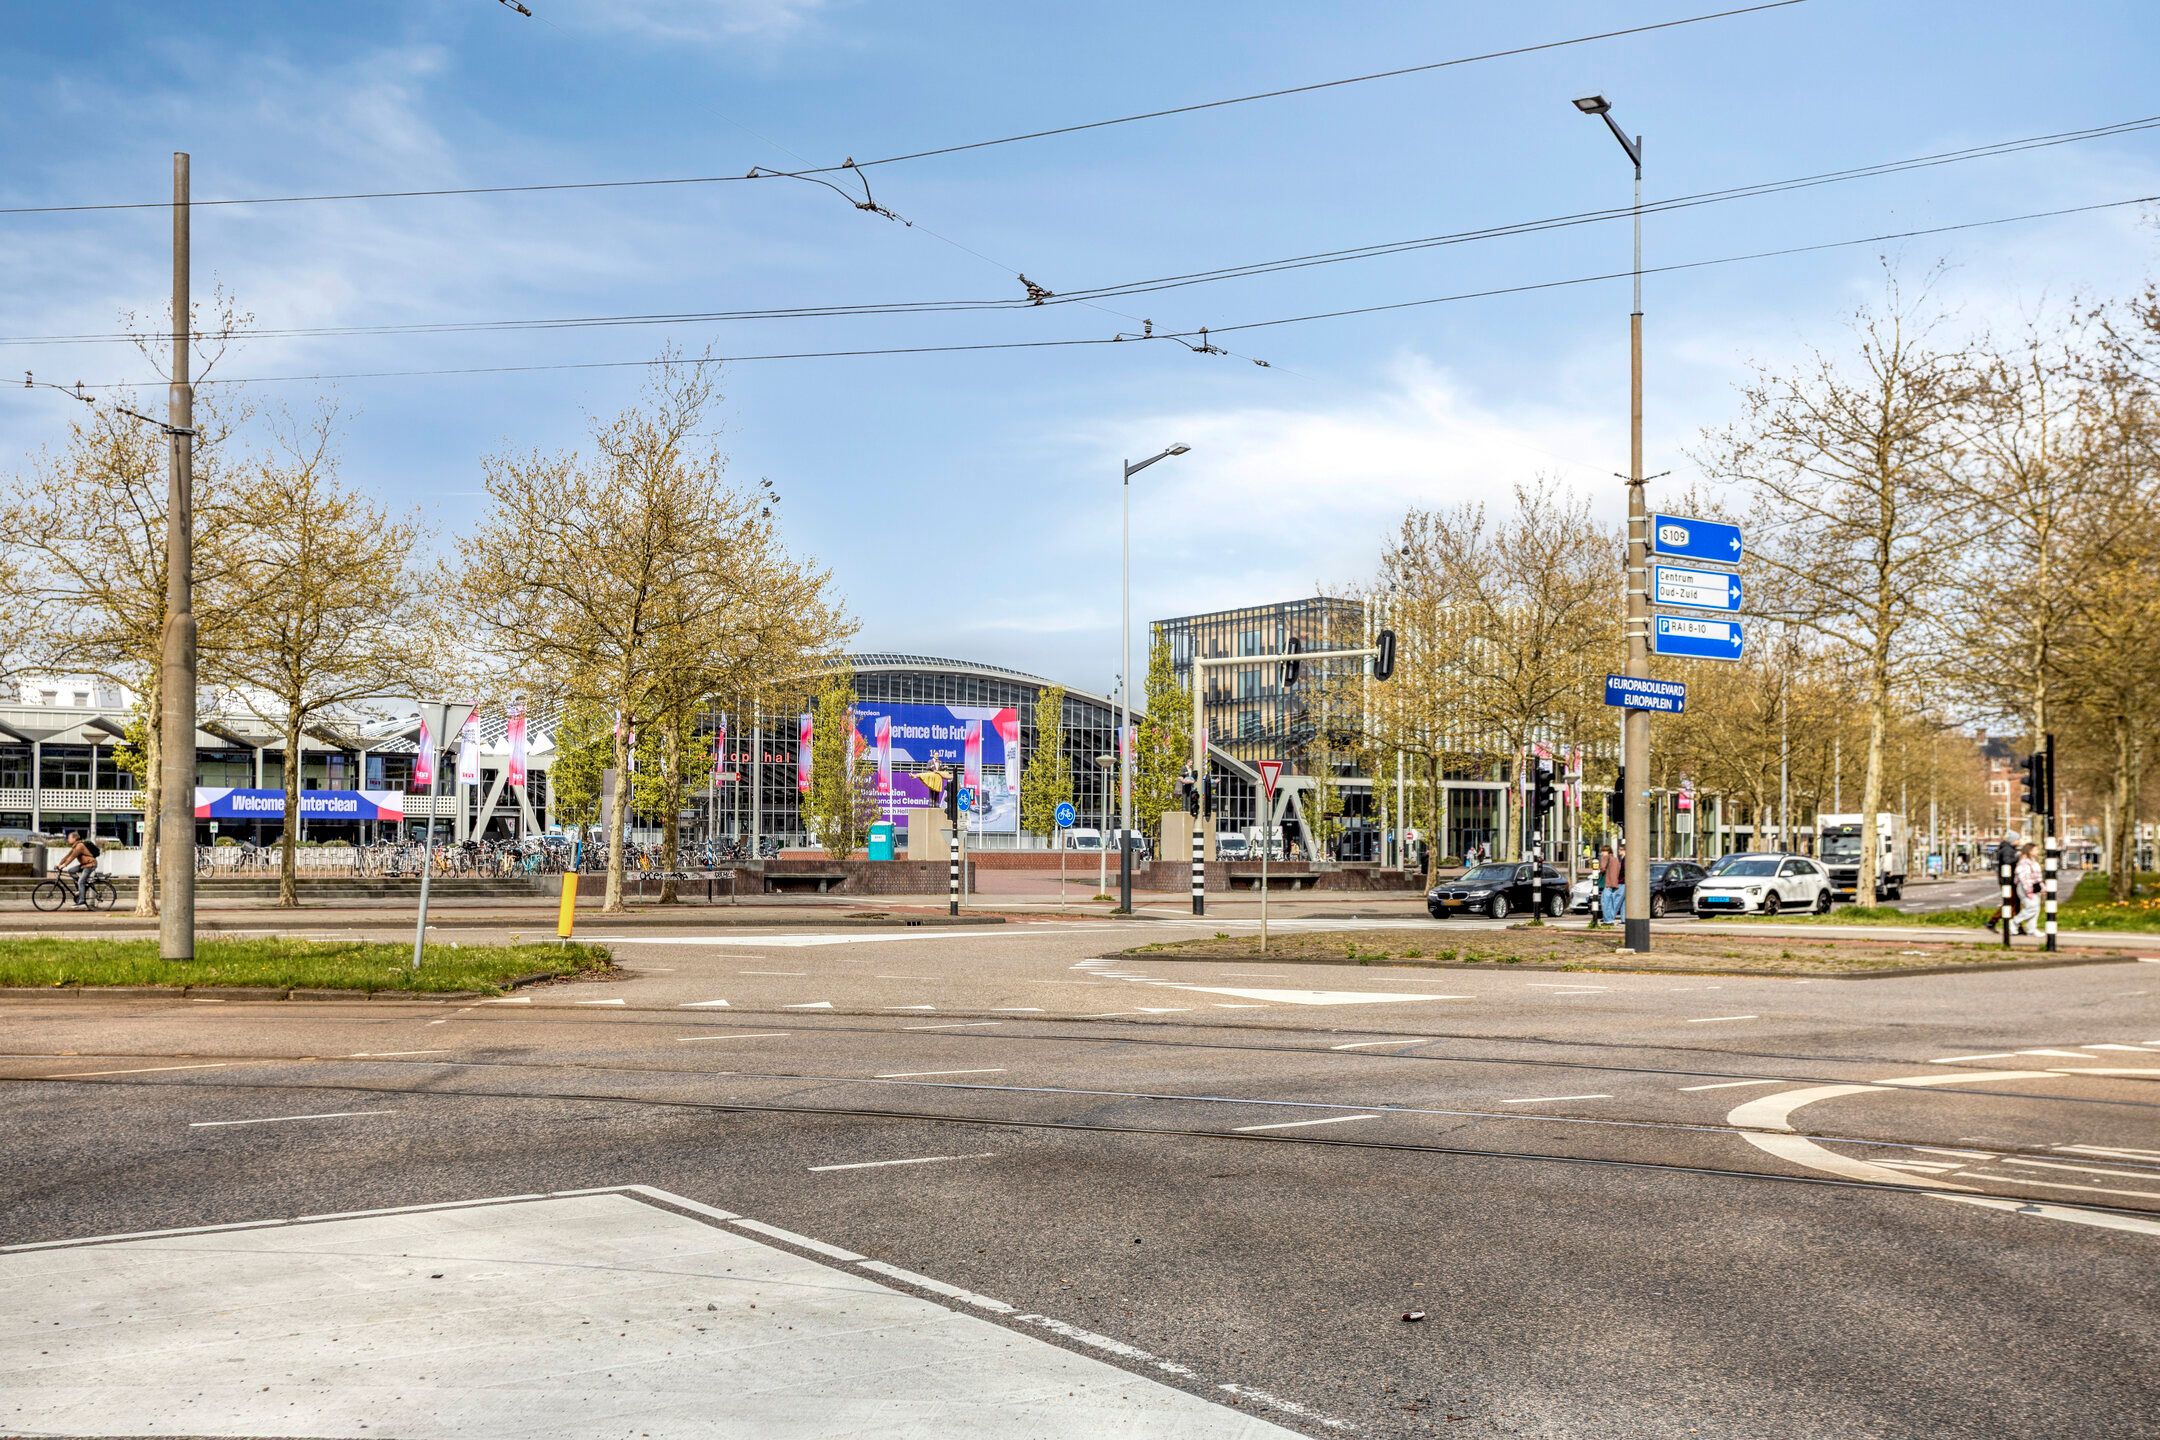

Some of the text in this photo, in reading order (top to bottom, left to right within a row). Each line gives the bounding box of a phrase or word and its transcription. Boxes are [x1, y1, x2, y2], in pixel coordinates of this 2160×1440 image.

[1659, 571, 1694, 583] Centrum
[1659, 586, 1698, 599] Oud-Zuid
[1671, 621, 1686, 632] RAI
[1688, 623, 1707, 634] 8-10
[1613, 678, 1685, 697] EUROPABOULEVARD
[1624, 694, 1673, 710] EUROPAPLEIN
[854, 709, 881, 717] nterclean
[931, 725, 948, 740] the
[944, 749, 957, 760] April
[232, 795, 357, 812] Welcome Interclean
